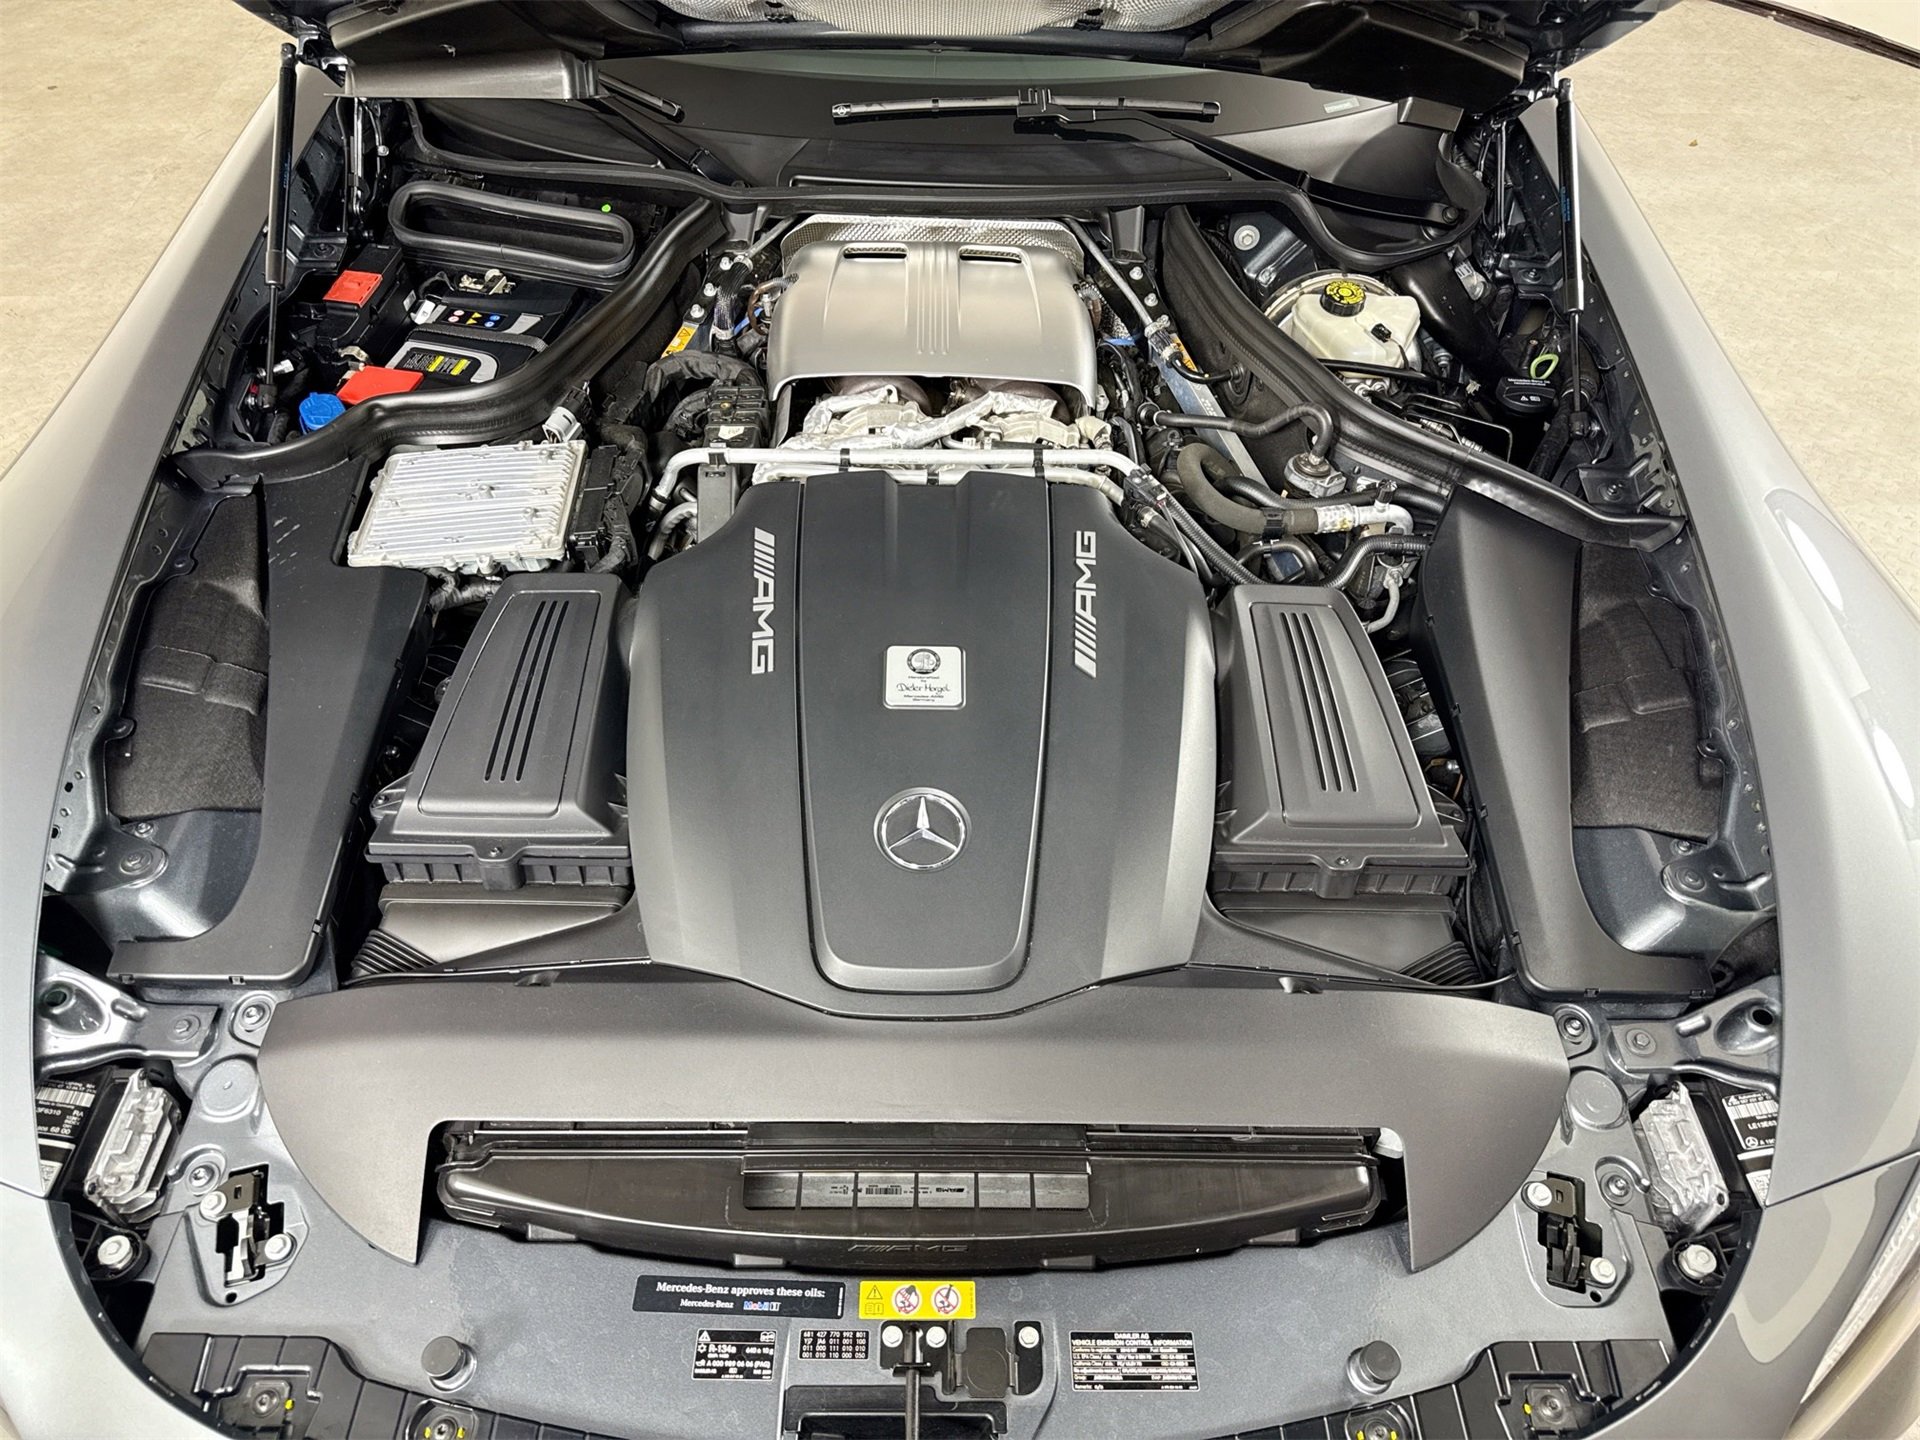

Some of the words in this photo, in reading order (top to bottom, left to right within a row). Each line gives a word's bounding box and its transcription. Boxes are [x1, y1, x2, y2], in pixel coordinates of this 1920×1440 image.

[1075, 530, 1097, 624] AMG
[751, 571, 775, 675] AMG
[656, 1282, 729, 1294] Mercedes-Benz
[731, 1285, 775, 1297] approves
[777, 1286, 803, 1298] these
[804, 1288, 825, 1298] oils:
[680, 1299, 734, 1308] Mercedes-Benz
[708, 1343, 737, 1354] R-134a
